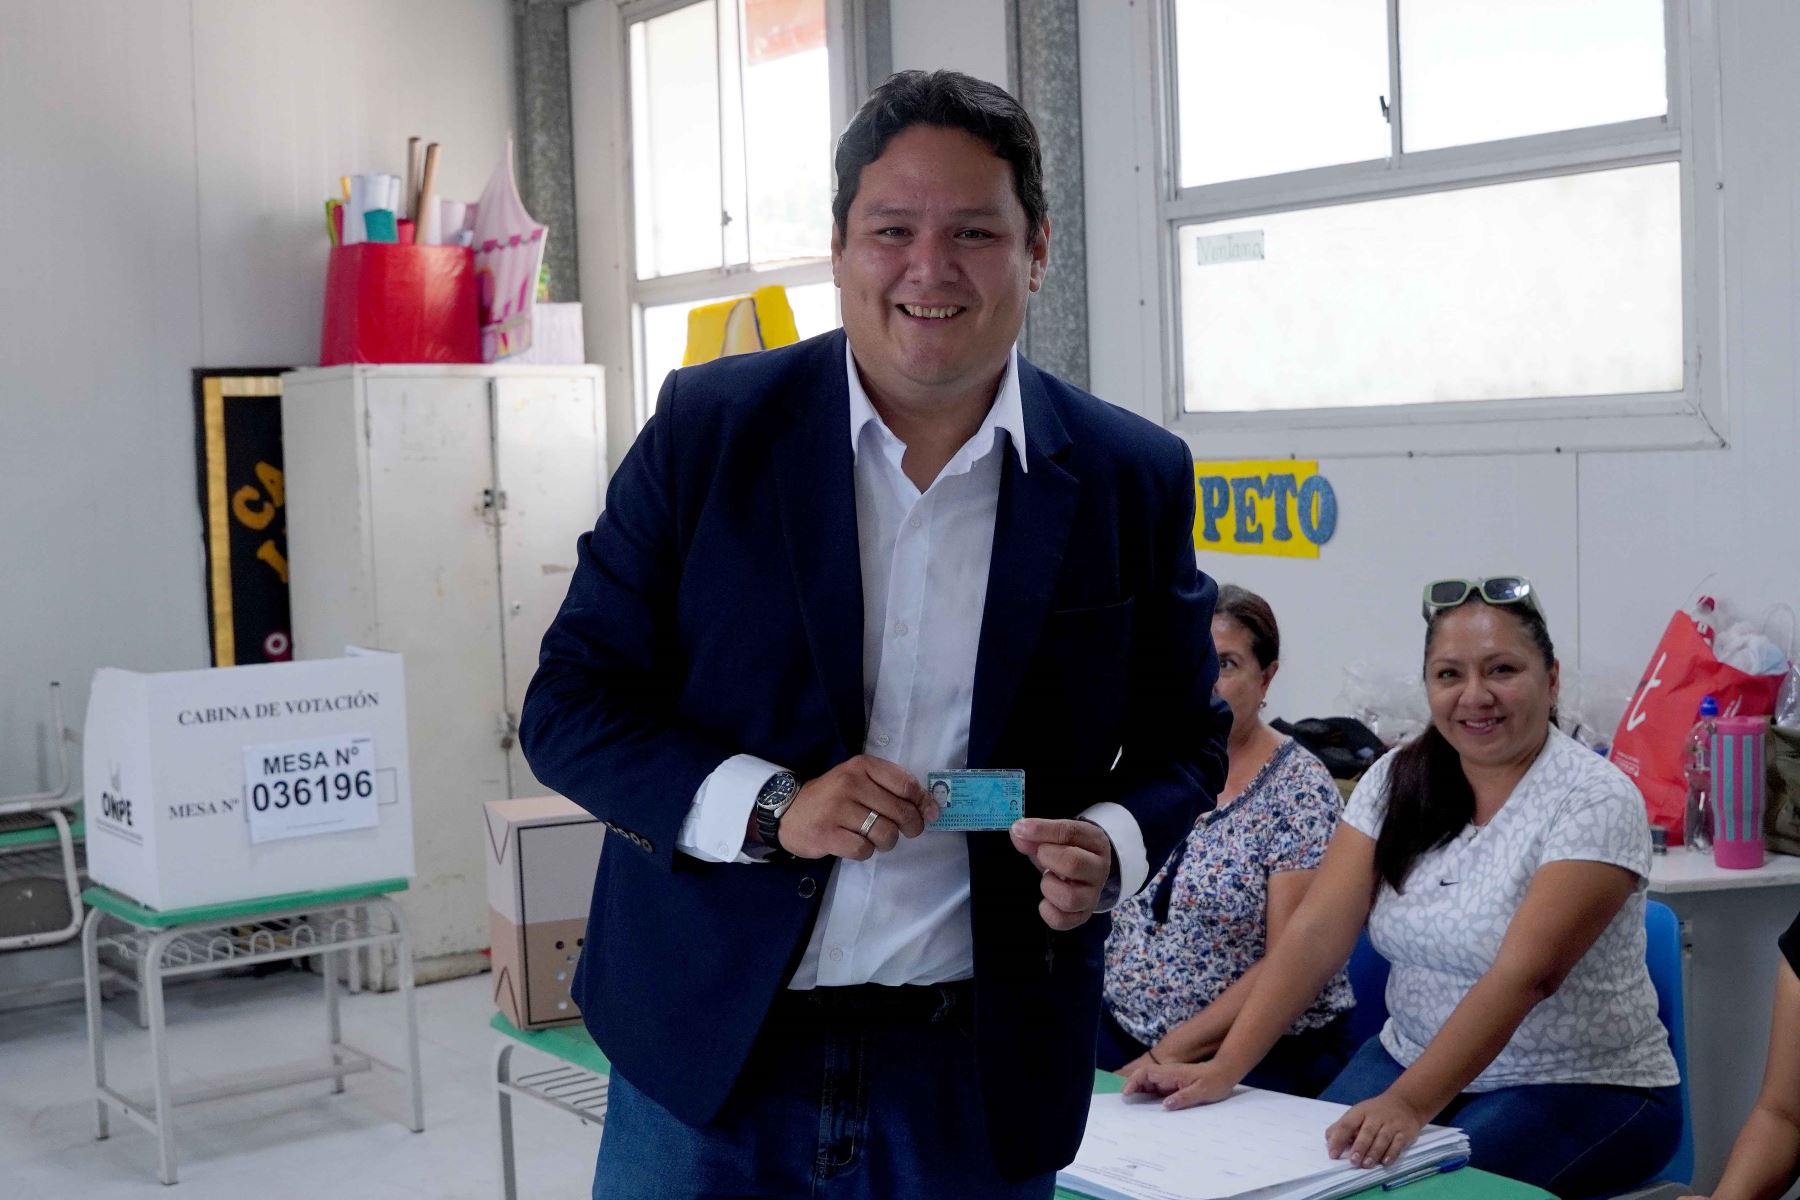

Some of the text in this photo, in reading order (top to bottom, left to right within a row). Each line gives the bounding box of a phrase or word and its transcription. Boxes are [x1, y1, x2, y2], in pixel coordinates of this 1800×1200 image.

[1198, 473, 1338, 545] PETO
[178, 690, 380, 726] CABINA DE VOTACIÓN
[263, 751, 329, 775] MESA
[102, 791, 132, 827] ONPE
[252, 770, 372, 812] 036196
[168, 802, 217, 820] MESA
